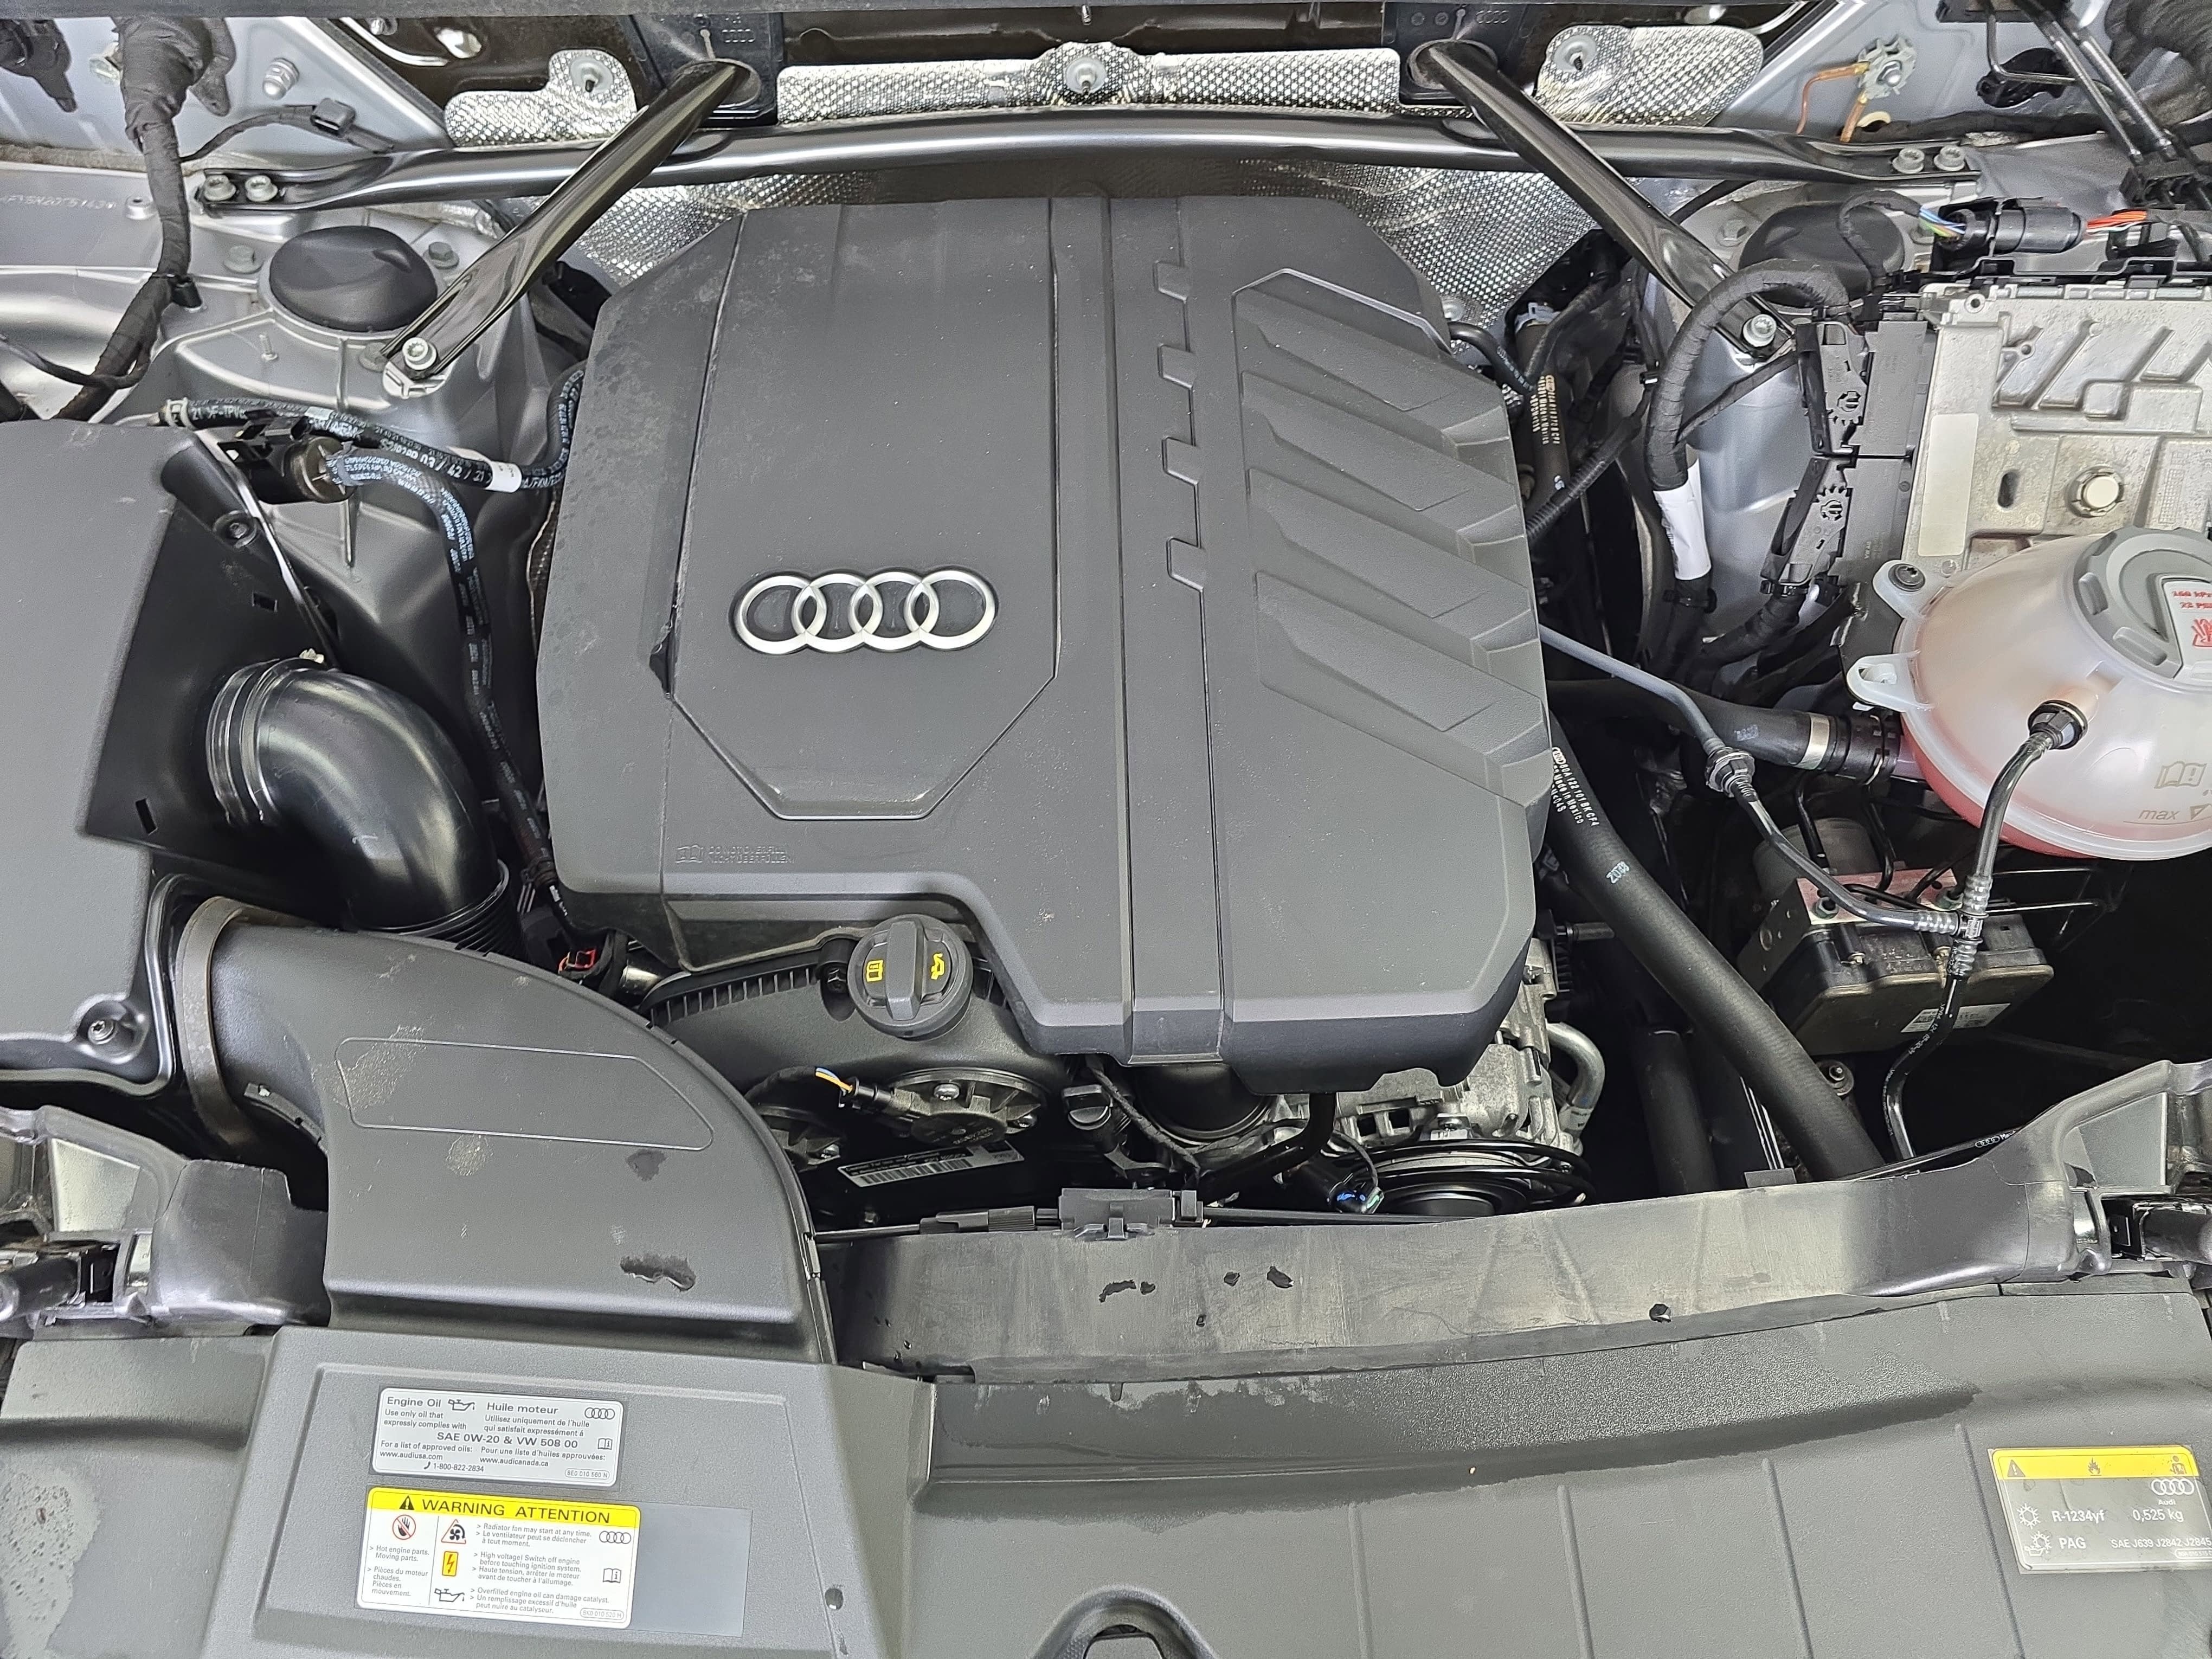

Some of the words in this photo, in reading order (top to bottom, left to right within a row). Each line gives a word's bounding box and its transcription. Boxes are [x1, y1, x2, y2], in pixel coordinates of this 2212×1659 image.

[2138, 809, 2179, 820] max
[387, 1397, 423, 1407] Engine
[427, 1398, 441, 1407] Oil
[487, 1402, 514, 1411] Huile
[518, 1405, 558, 1414] moteur
[401, 1410, 416, 1418] only
[384, 1420, 417, 1428] expressly
[418, 1421, 449, 1430] complies
[485, 1414, 510, 1423] Utilisez
[512, 1417, 555, 1426] uniquement
[497, 1425, 525, 1433] satisfait
[437, 1432, 460, 1441] SAE
[464, 1434, 500, 1443] 0W-20
[504, 1436, 513, 1444] &
[517, 1437, 537, 1446] VW
[541, 1439, 561, 1448] 508
[564, 1440, 578, 1448] 00
[380, 1451, 443, 1460] www.audiusa.com
[562, 1452, 606, 1461] approuvées:
[480, 1457, 549, 1467] www.audicanada.ca
[433, 1463, 484, 1472] 1-800-822-2834
[422, 1499, 505, 1516] WARNING
[515, 1506, 610, 1523] ATTENTION
[2052, 1510, 2105, 1524] R-1234yf
[2133, 1509, 2165, 1523] 0,525
[2167, 1509, 2184, 1522] kg
[484, 1523, 511, 1532] Radiator
[524, 1527, 537, 1535] may
[492, 1532, 526, 1540] ventilateur
[552, 1535, 586, 1544] déclencher
[2059, 1538, 2086, 1549] PAG
[2111, 1540, 2130, 1549] SAE
[2133, 1539, 2153, 1548] J639
[2155, 1539, 2182, 1547] J2842
[2183, 1538, 2211, 1546] J2845
[375, 1553, 399, 1561] Moving
[480, 1551, 496, 1559] High
[501, 1560, 530, 1570] touching
[531, 1562, 555, 1572] ignition
[499, 1567, 524, 1576] tension,
[371, 1589, 411, 1597] mouvement.
[478, 1587, 509, 1596] Overfilled
[510, 1590, 531, 1598] engine
[556, 1593, 582, 1603] damage
[583, 1594, 610, 1604] catalyst.
[488, 1596, 526, 1605] remplissage
[528, 1598, 554, 1606] excessif
[476, 1602, 491, 1610] peut
[519, 1604, 554, 1614] catalyseur.
